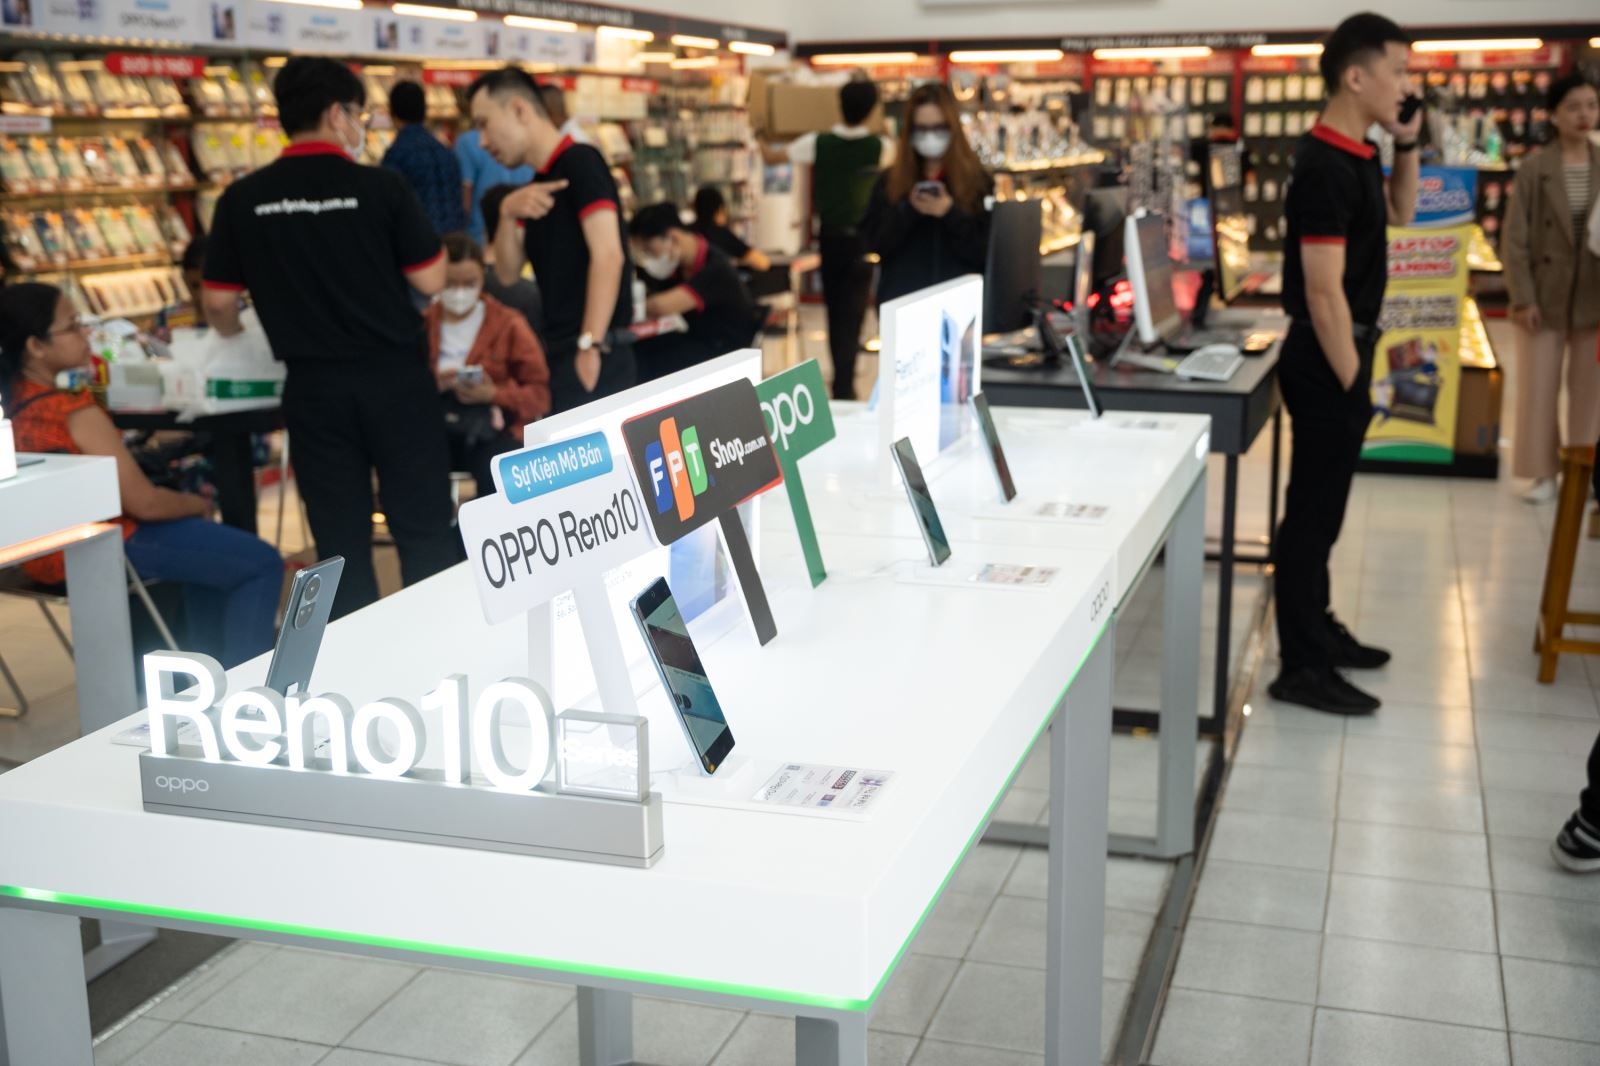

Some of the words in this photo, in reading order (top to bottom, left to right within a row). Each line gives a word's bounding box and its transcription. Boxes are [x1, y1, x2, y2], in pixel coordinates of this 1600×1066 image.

[511, 465, 530, 492] Sự
[529, 456, 560, 485] Kiện
[558, 450, 579, 474] Mở
[577, 443, 603, 468] Bán
[481, 518, 560, 589] OPPO
[558, 488, 639, 558] Reno10
[143, 650, 553, 791] Reno10
[155, 773, 210, 793] oppo
